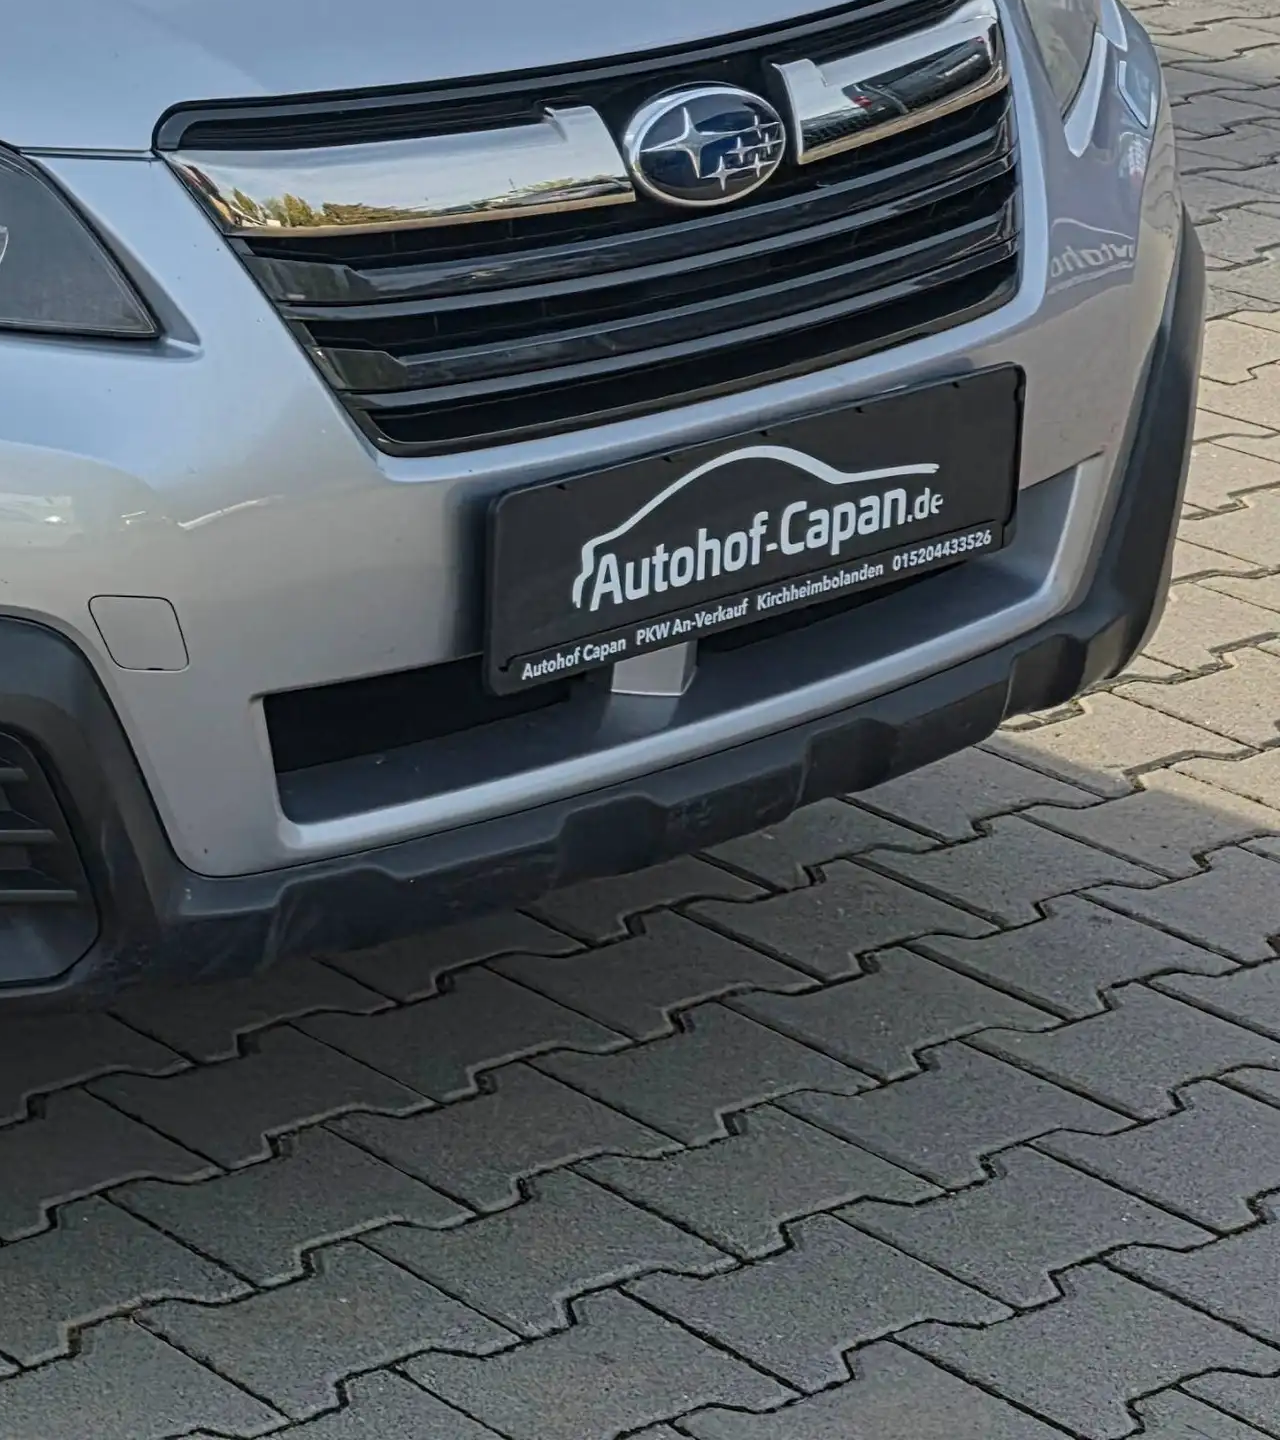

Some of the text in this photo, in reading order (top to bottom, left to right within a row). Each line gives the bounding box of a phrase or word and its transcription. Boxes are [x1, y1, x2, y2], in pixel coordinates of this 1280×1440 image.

[521, 528, 992, 680] Autohof Capan PKW An-Verkauf Kirchheimbolanden 015204433526
[590, 487, 943, 611] Autohof-Capan.de
